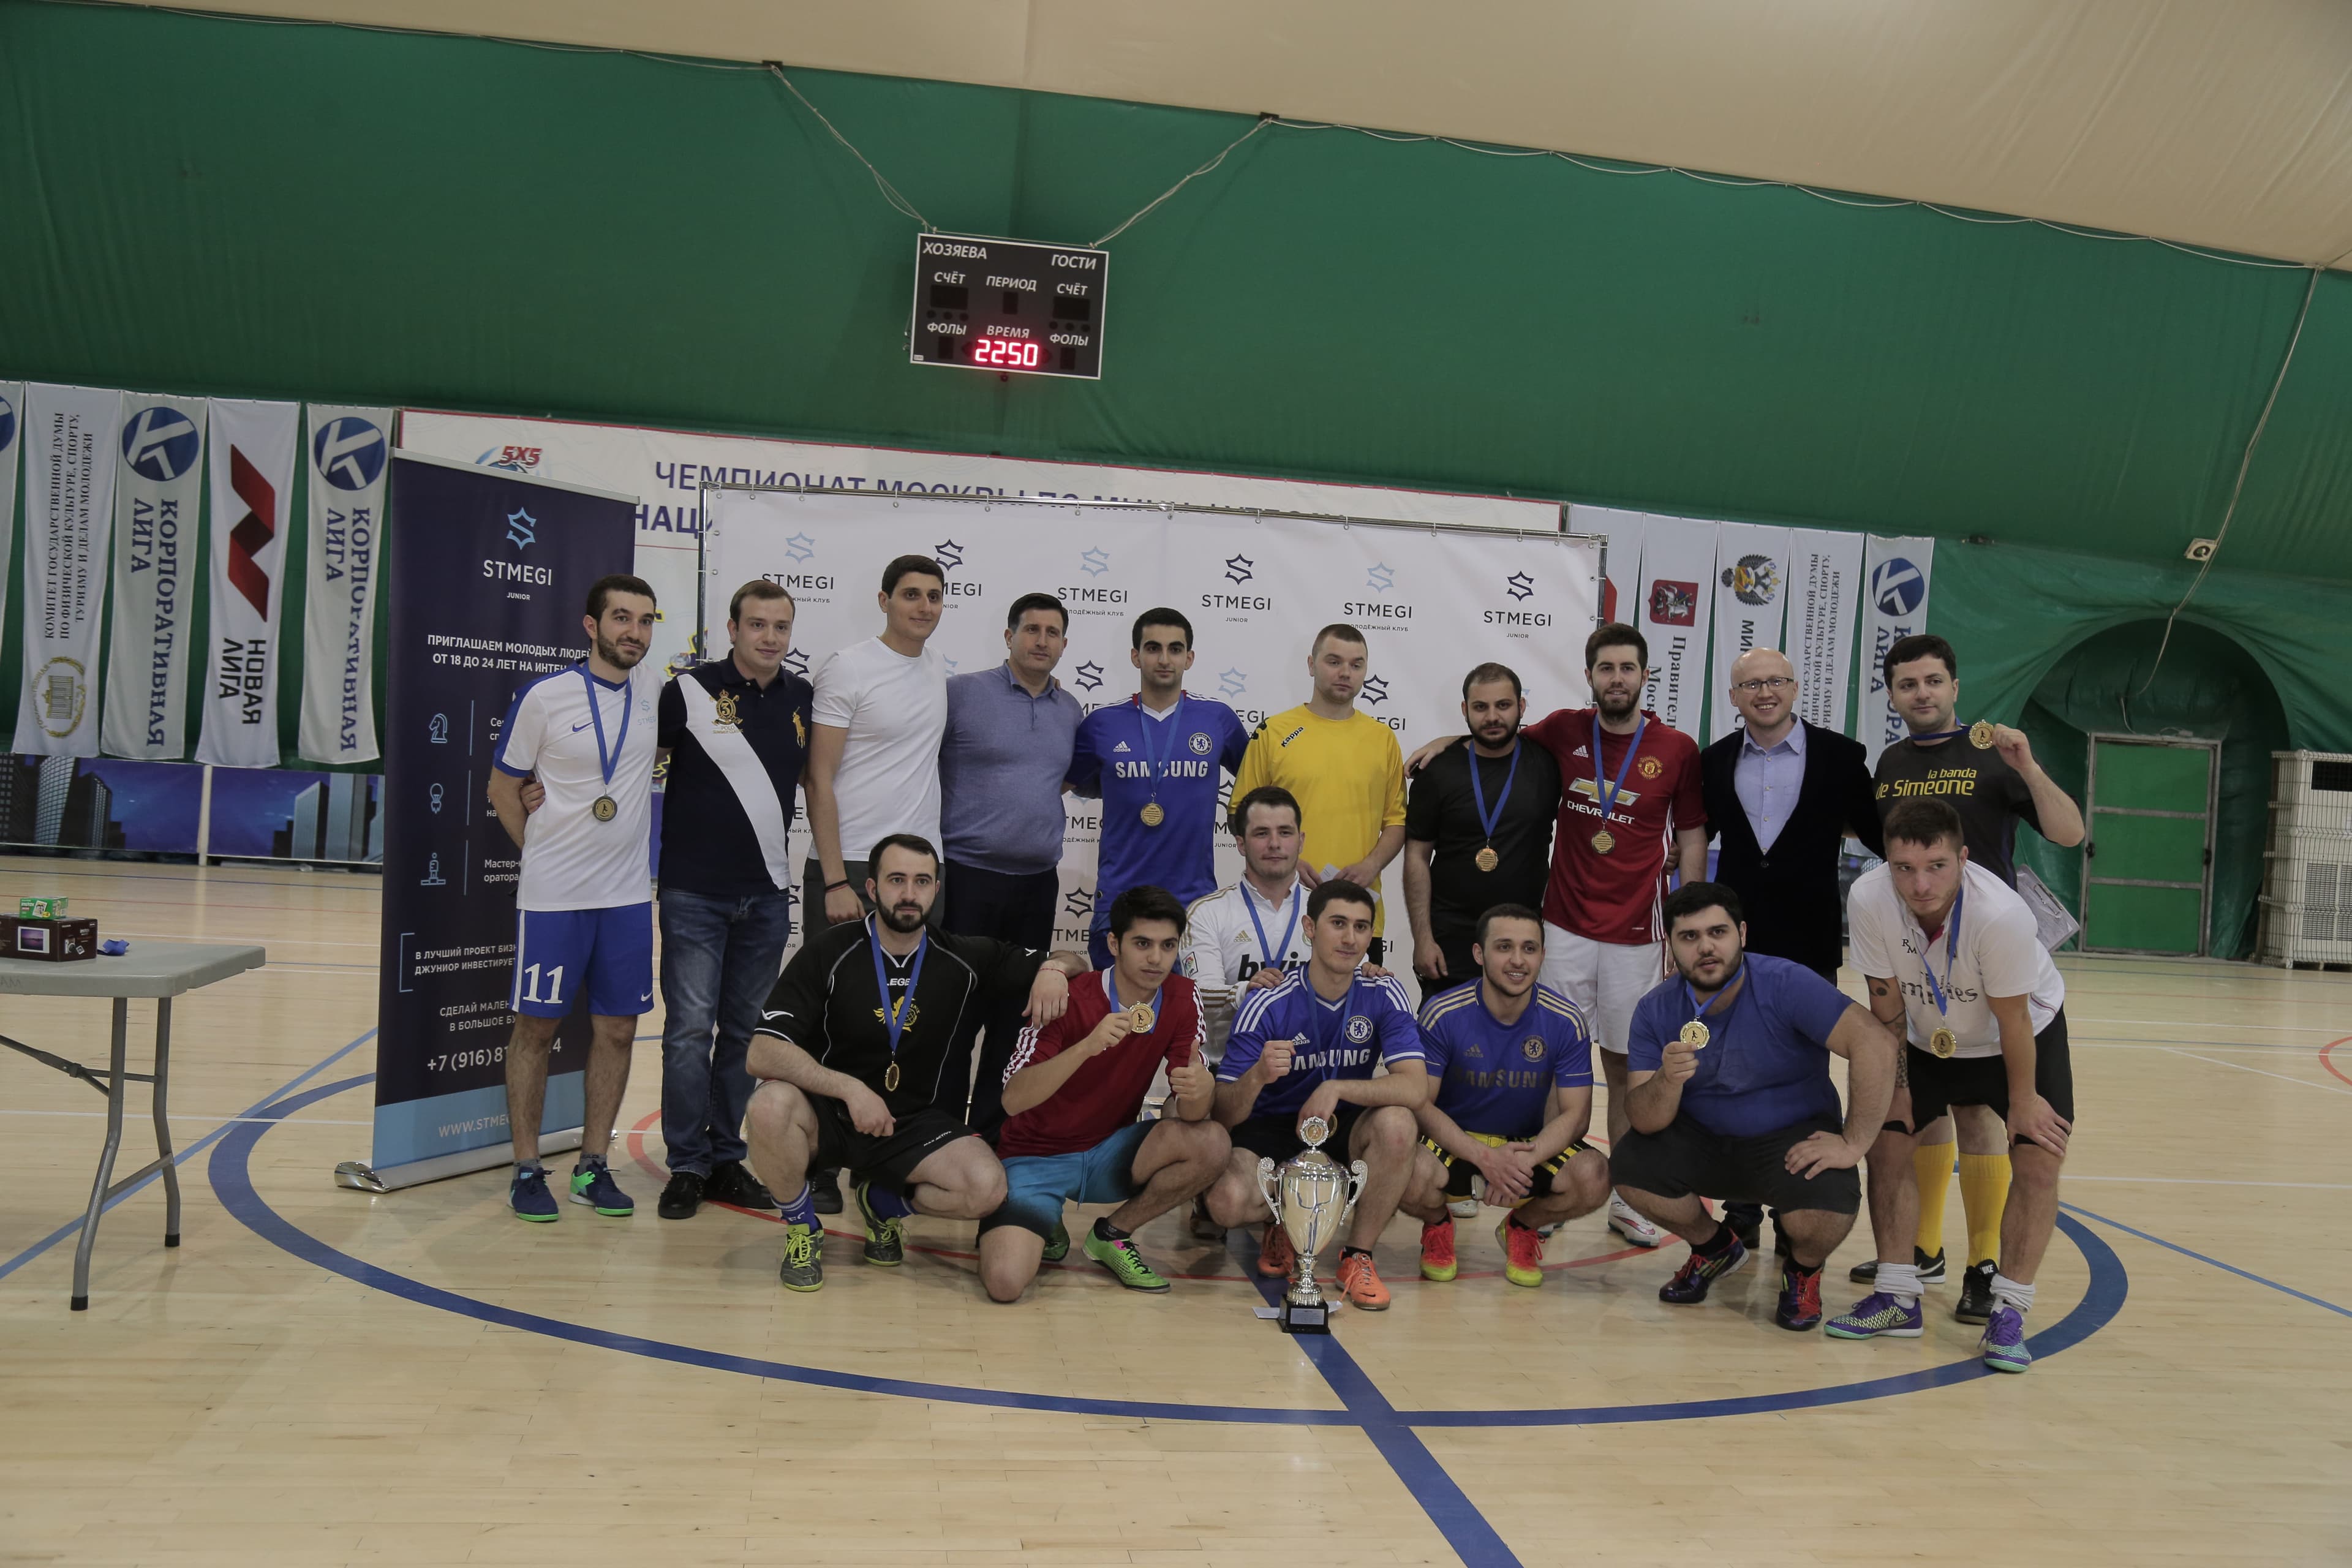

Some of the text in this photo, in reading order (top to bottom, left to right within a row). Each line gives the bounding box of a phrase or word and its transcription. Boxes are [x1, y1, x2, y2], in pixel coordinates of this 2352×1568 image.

[923, 242, 1097, 270] ХОЗЯЕВА ГОСТИ
[933, 271, 965, 284] СЧЁТ
[986, 276, 1037, 292] ПЕРИОД
[1057, 283, 1088, 296] СЧЁТ
[927, 322, 967, 335] ФОЛЫ
[986, 325, 1030, 339] ВРЕМЯ
[1049, 333, 1089, 346] ФОЛЫ
[975, 339, 1039, 366] 2250
[80, 433, 92, 504] МОЛОДЕЖИ
[45, 413, 64, 638] КОМИТЕТ ГОСУДАРСТВЕННОЙ ДУМЫ
[60, 414, 80, 639] ПО ФИЗИЧЕСКОЙ КУЛЬТУРЕ, СПОРТУ,
[78, 508, 89, 551] ДЕЛАМ
[131, 498, 154, 573] ЛИГА
[326, 508, 345, 581] ЛИГА
[483, 559, 552, 586] STMEGI
[75, 567, 86, 622] ТУРИЗМУ
[943, 582, 982, 597] EGI
[1058, 587, 1128, 603] STMEGI
[1202, 595, 1271, 610] STMEGI
[1344, 603, 1412, 619] STMEGI
[1828, 571, 1840, 636] МОЛОДЕЖИ
[147, 499, 178, 747] КОРПОРАТИВНАЯ
[341, 507, 371, 752] КОРПОРАТИВНАЯ
[1484, 611, 1551, 627] STMEGI
[1803, 590, 1815, 699] ГОСУДАРСТВЕННОЙ
[1809, 554, 1819, 587] ДУМЫ
[428, 635, 502, 652] ПРИГЛАШАЕМ
[505, 643, 557, 657] МОЛОДЫХ
[1825, 637, 1834, 676] ДЕЛАМ
[219, 638, 244, 699] ЛИГА
[433, 653, 447, 664] ОТ
[450, 654, 461, 665] 18
[463, 657, 479, 668] ДО
[482, 658, 494, 668] 24
[496, 659, 517, 670] ЛЕТ
[519, 661, 533, 672] НА
[243, 639, 266, 725] НОВАЯ
[1811, 661, 1822, 725] ИЗИЧЕСКОЙ
[1281, 726, 1304, 748] Kappa
[1928, 768, 1977, 779] la banda
[1875, 779, 1975, 800] de Simeone
[415, 951, 421, 960] В
[423, 947, 461, 959] ЛУЧШИЙ
[464, 946, 496, 956] ПРОЕКТ
[415, 963, 459, 976] ДЖУНИОР
[523, 963, 563, 1003] 11
[440, 1001, 477, 1017] СДЕЛАЙ
[450, 1022, 456, 1031] В
[458, 1016, 503, 1031] БОЛЬШОЕ
[1289, 1049, 1371, 1071] AMSUNG
